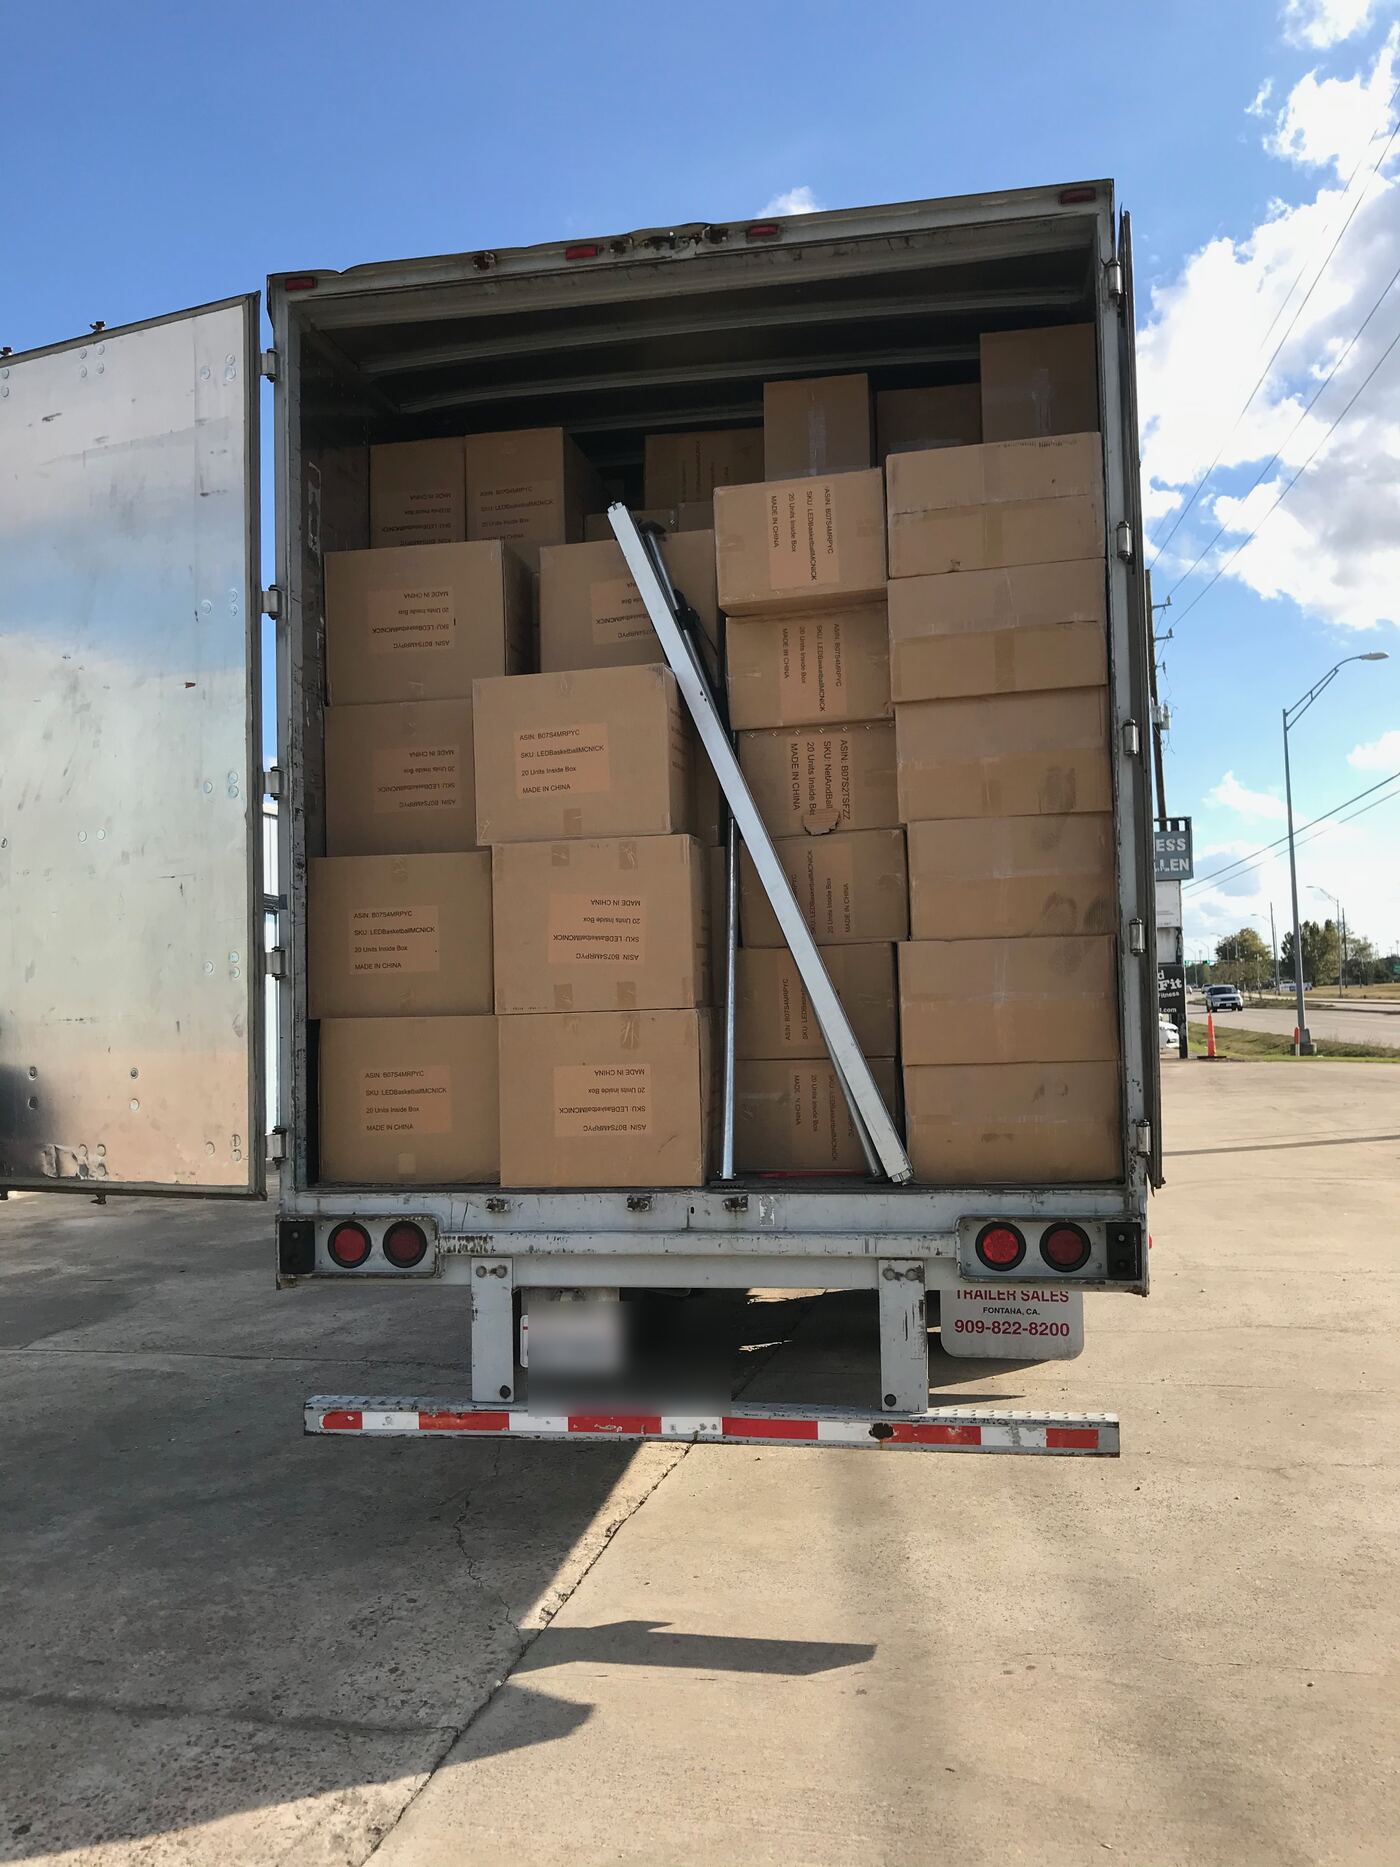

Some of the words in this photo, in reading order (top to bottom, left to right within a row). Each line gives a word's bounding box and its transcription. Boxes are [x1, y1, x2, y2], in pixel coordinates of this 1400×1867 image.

[788, 493, 795, 502] 20
[788, 502, 796, 519] Units
[799, 626, 806, 635] 20
[537, 729, 580, 739] B07S4MRPYC
[807, 742, 815, 752] 20
[790, 743, 799, 769] MADE
[807, 754, 815, 775] Units
[521, 769, 529, 777] 20
[792, 771, 799, 781] IN
[522, 786, 541, 794] MADE
[550, 783, 571, 791] CHINA
[808, 777, 816, 801] Inside
[841, 765, 850, 820] B07S2TSFZZ
[792, 782, 801, 811] CHINA
[1156, 838, 1186, 852] ESS
[576, 953, 620, 961] B07S4MRPYC
[594, 1069, 616, 1077] CHINA
[625, 1068, 645, 1076] MADE
[583, 1124, 627, 1132] B07S4MRPYC
[957, 1290, 1017, 1301] TRAILER
[1020, 1290, 1069, 1303] SALES
[1026, 1308, 1040, 1316] CA.
[954, 1319, 1070, 1337] 909-822-8200
